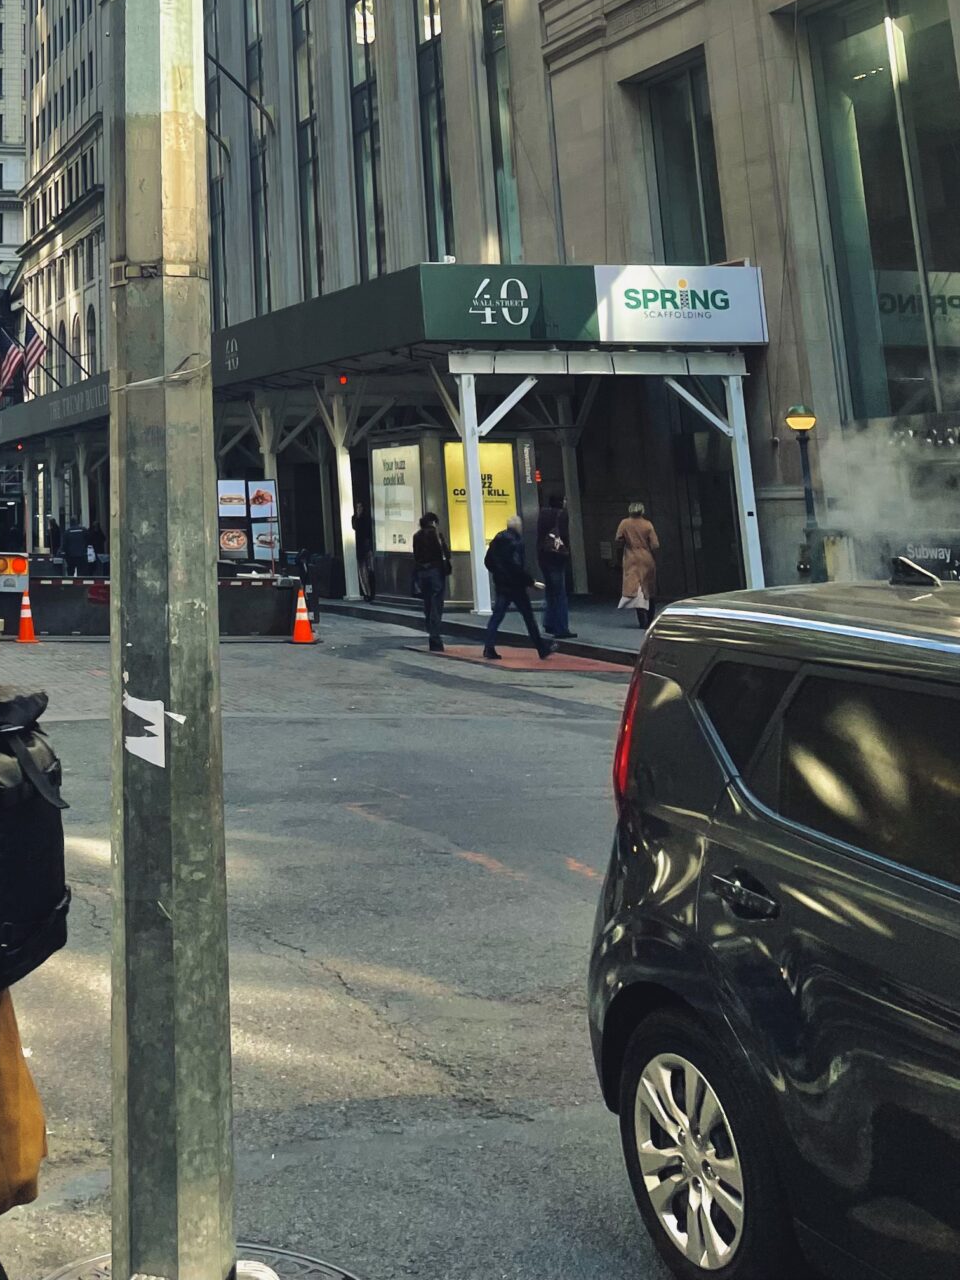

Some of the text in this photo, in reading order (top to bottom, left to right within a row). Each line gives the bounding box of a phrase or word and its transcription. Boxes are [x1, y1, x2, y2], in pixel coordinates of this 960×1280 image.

[468, 278, 529, 326] 40
[472, 299, 525, 307] WALL STREET
[624, 279, 730, 312] SPRING
[643, 310, 712, 320] SCAFFOLDING
[382, 458, 406, 471] Your buzz
[906, 543, 952, 564] Subway
